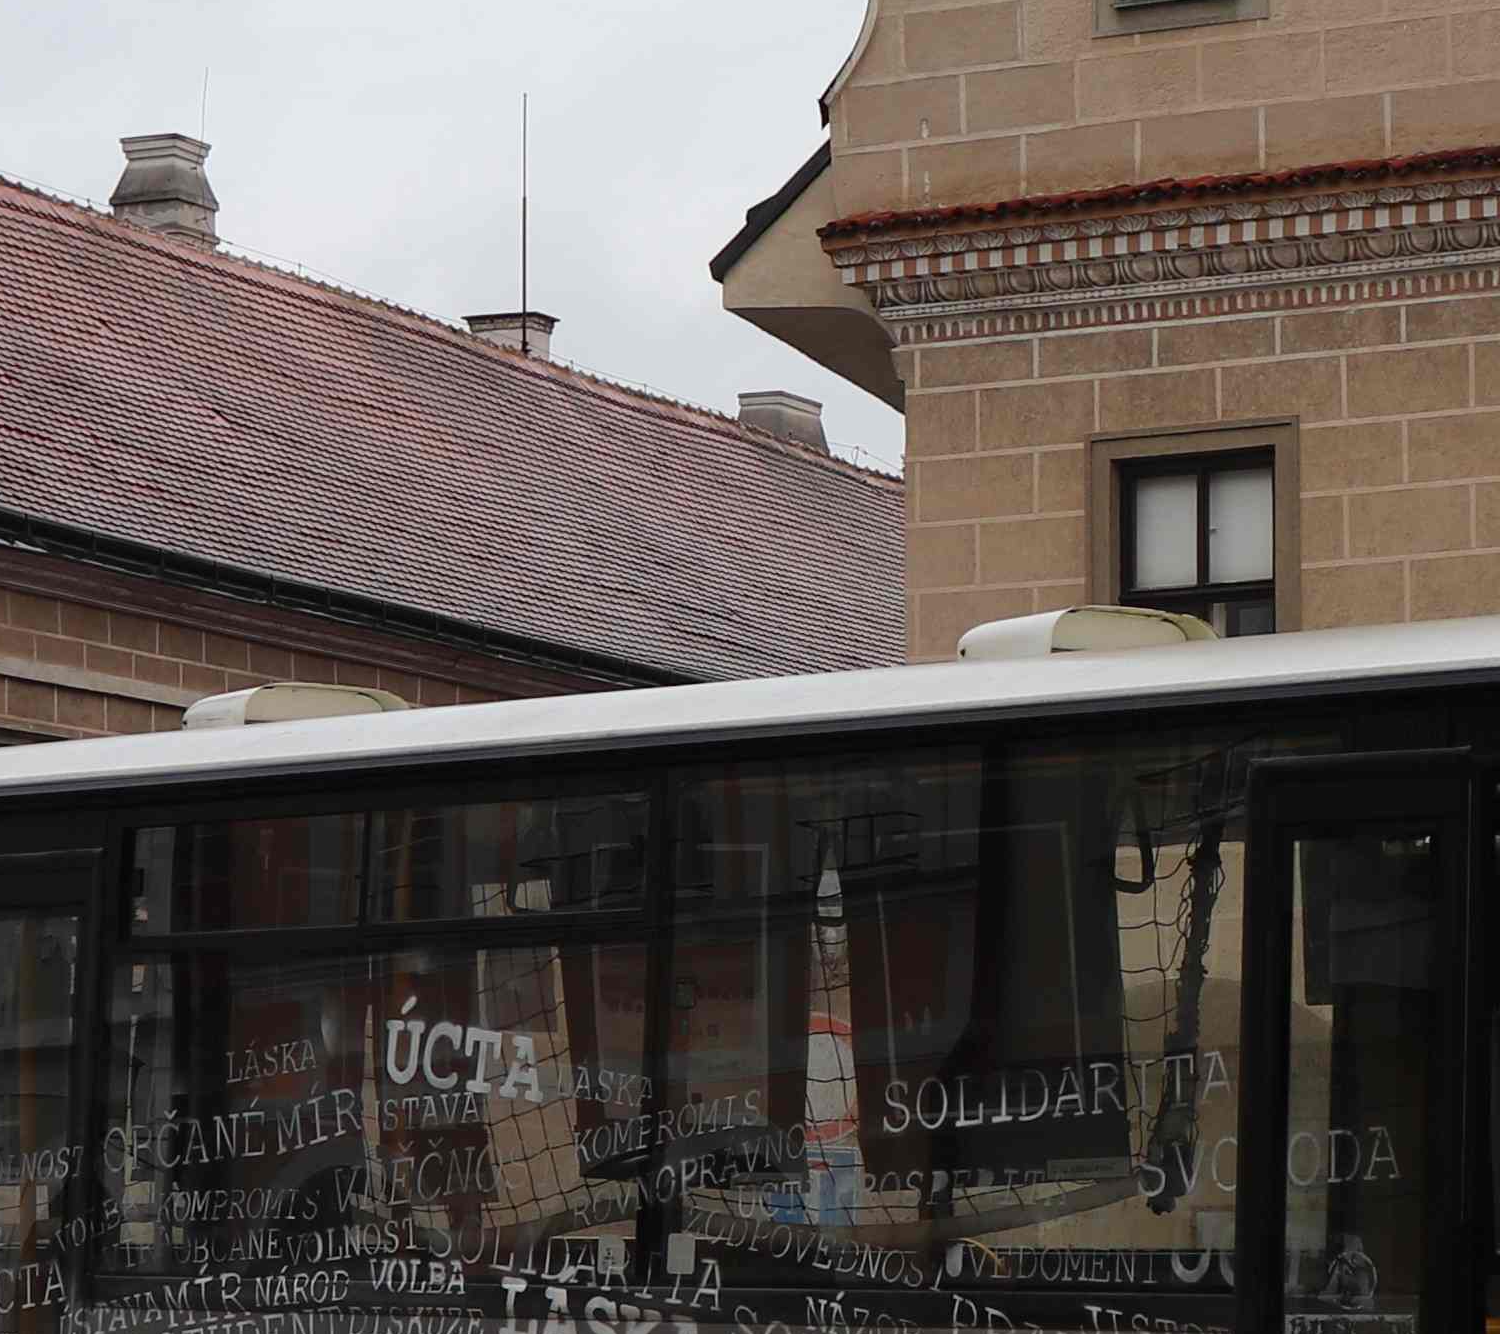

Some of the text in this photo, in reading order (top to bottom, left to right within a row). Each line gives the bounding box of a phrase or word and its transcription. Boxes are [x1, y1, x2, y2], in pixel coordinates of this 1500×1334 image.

[225, 1036, 319, 1084] LÁSKA
[384, 994, 546, 1104] ÚCTA
[274, 1083, 363, 1157] MÍR
[882, 1049, 1233, 1135] SOLIDARITA
[1136, 1123, 1403, 1198] SVOODA
[161, 1263, 252, 1327] MÍR
[253, 1263, 353, 1308] NÁROD
[368, 1258, 468, 1296] VOLBA
